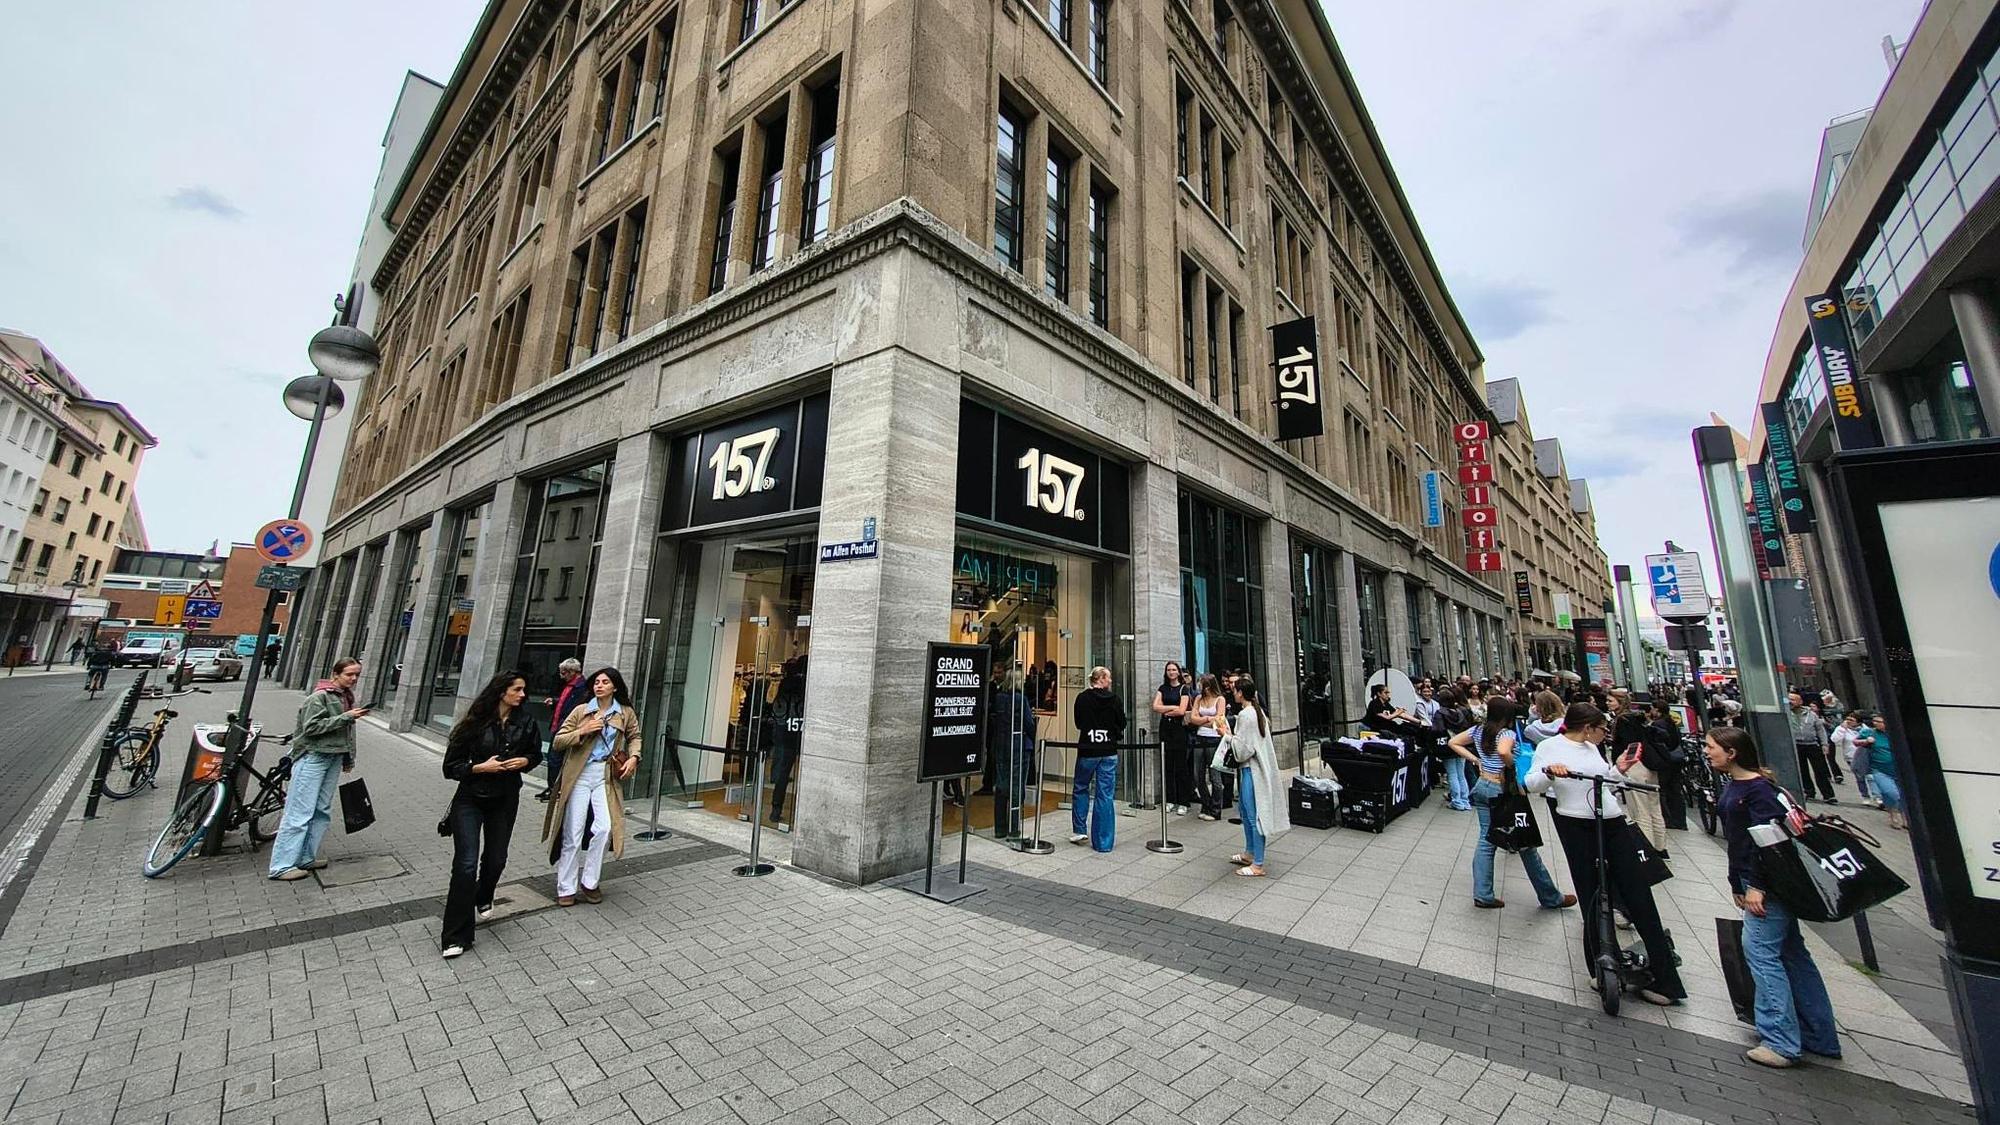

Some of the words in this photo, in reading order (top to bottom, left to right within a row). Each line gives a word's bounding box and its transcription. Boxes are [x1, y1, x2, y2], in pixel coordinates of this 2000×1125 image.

[1822, 345, 1862, 418] SUBWAY
[1776, 460, 1799, 489] PAN
[1425, 473, 1439, 526] Barmenia
[1758, 509, 1776, 532] PAN
[821, 547, 832, 558] Am
[850, 541, 876, 555] Posthof
[937, 657, 973, 670] GRAND
[936, 673, 980, 686] OPENING
[935, 696, 976, 706] DONNERSTAG
[934, 707, 943, 716] 11.
[943, 707, 958, 716] JUNI
[966, 753, 976, 763] 157
